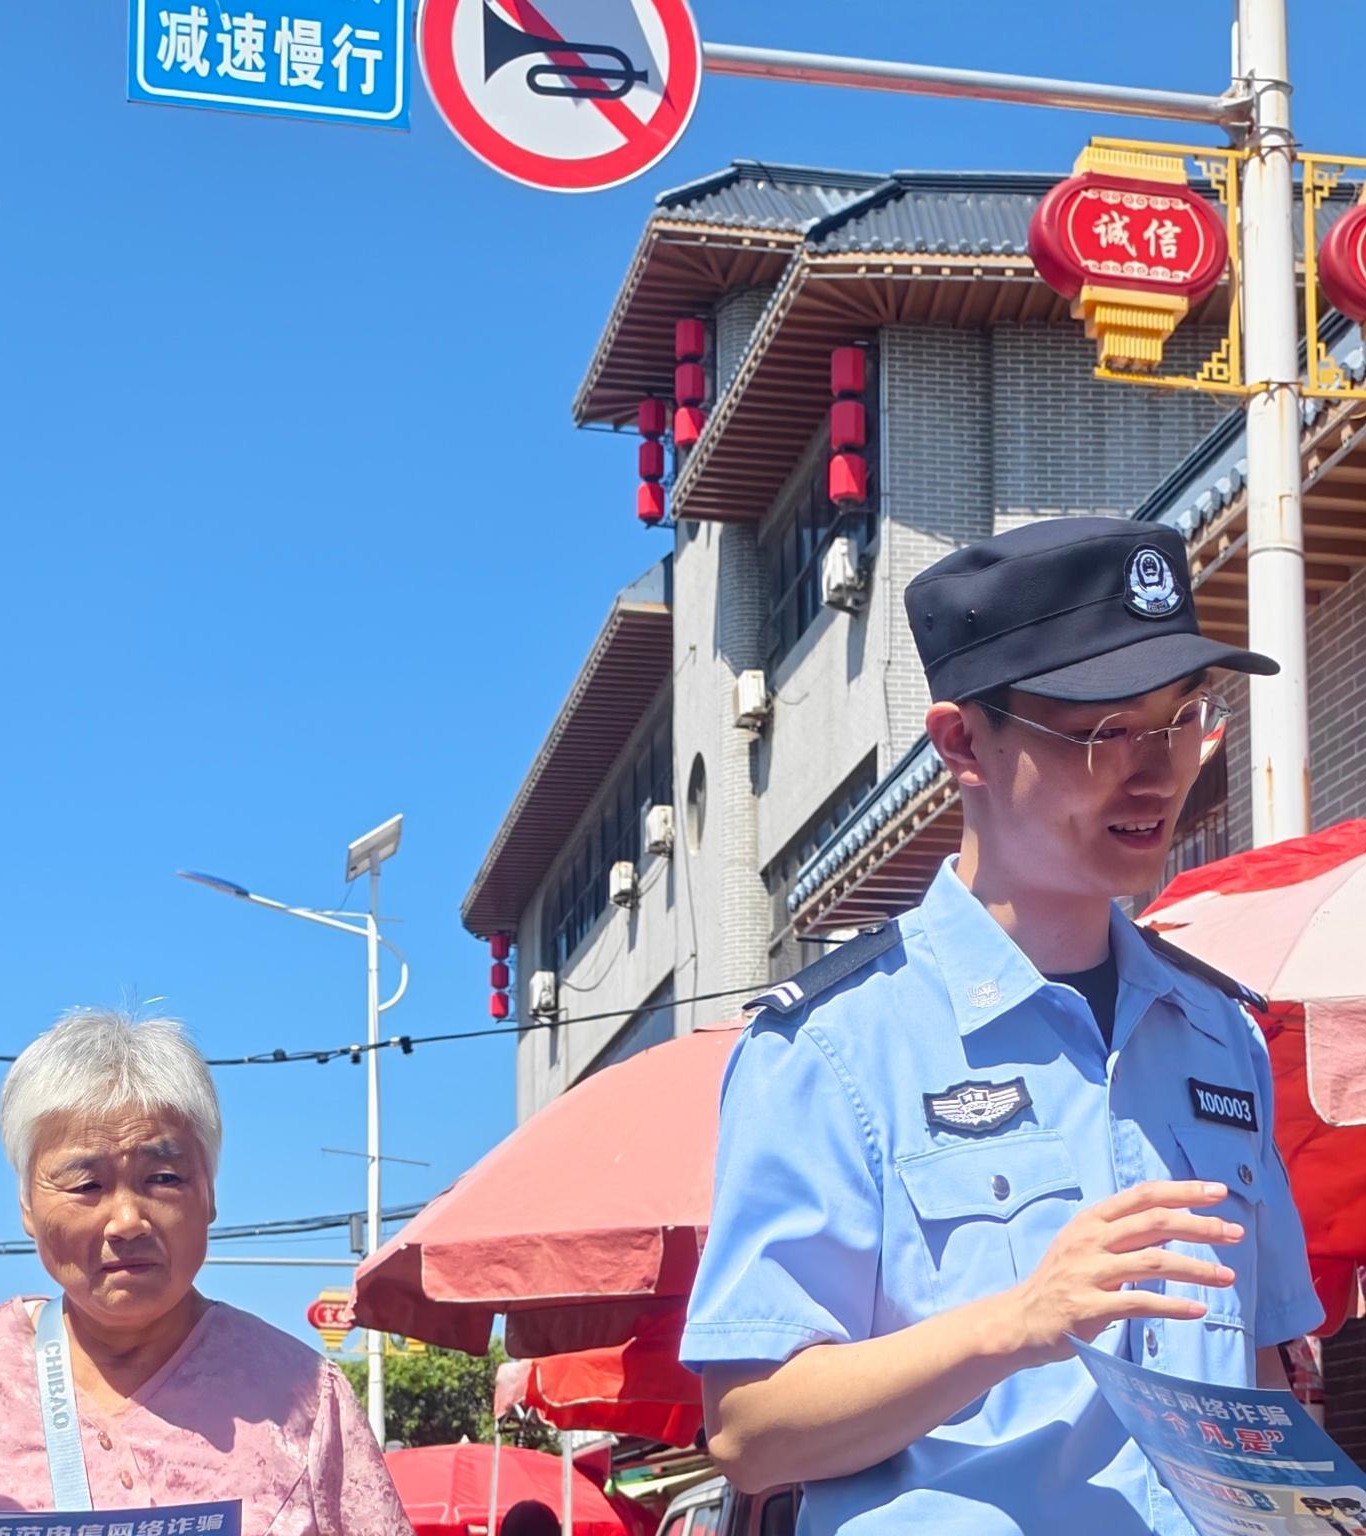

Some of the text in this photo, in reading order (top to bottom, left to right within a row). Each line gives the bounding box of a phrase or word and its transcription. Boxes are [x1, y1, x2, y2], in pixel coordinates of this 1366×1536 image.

[156, 5, 383, 95] 减速慢行
[1092, 212, 1182, 259] 诚信
